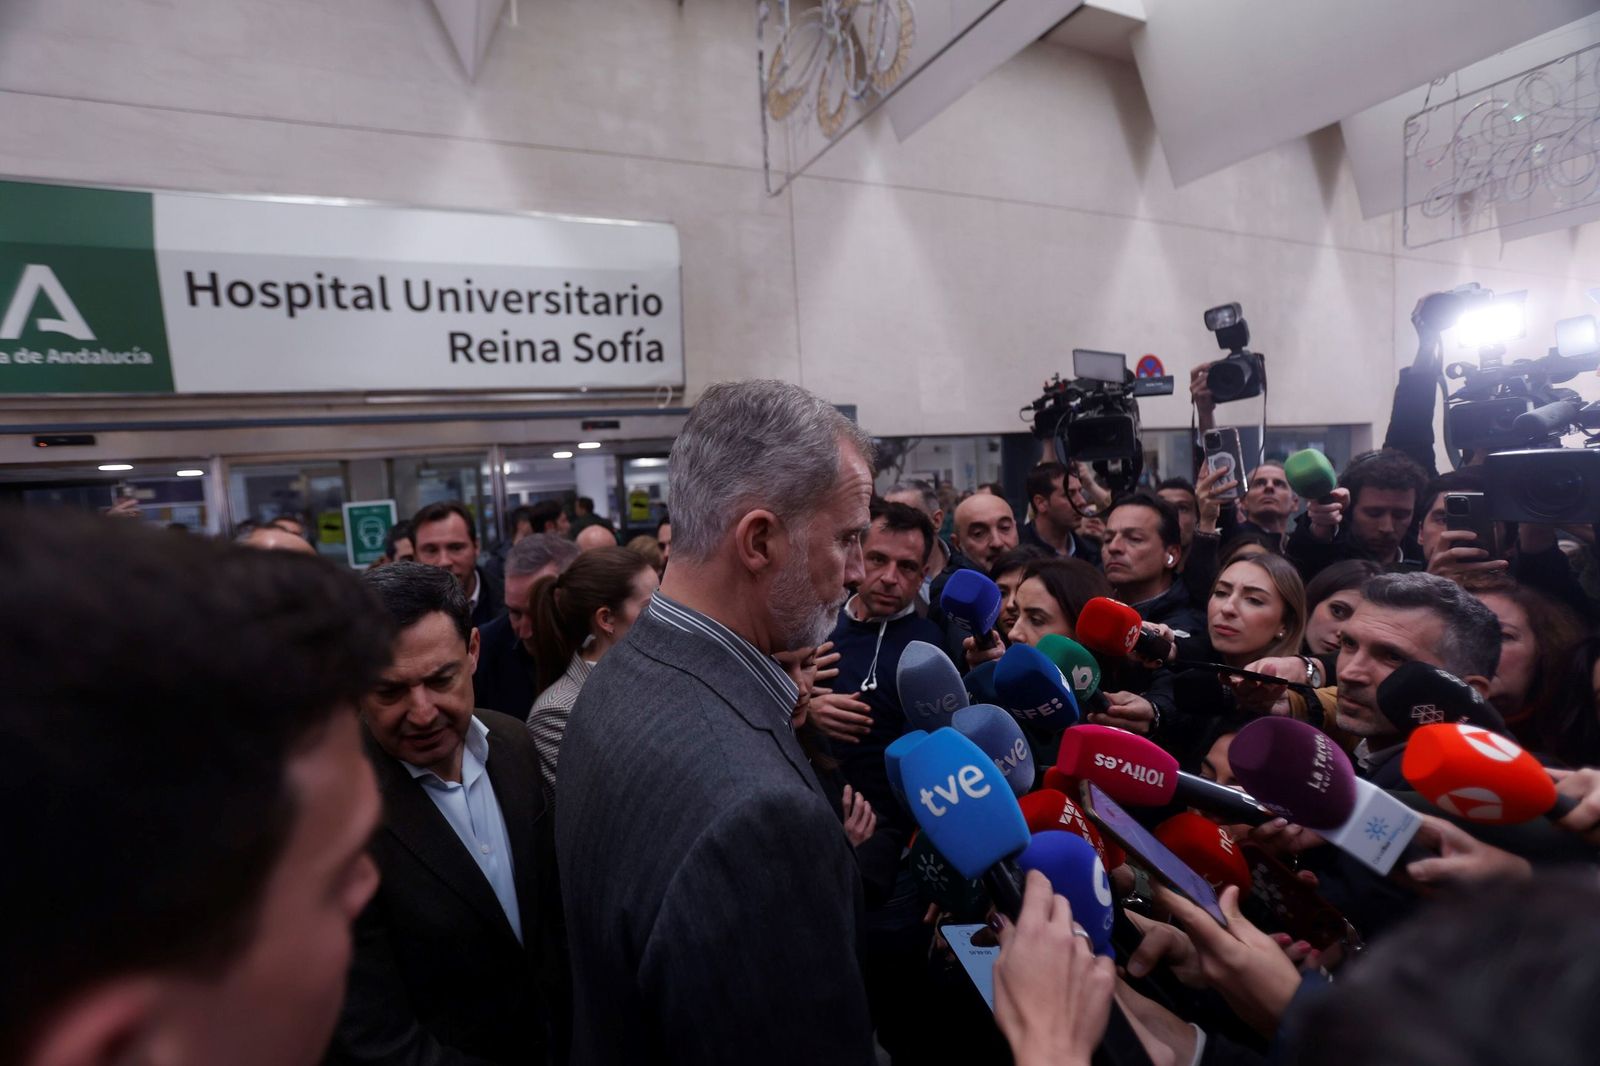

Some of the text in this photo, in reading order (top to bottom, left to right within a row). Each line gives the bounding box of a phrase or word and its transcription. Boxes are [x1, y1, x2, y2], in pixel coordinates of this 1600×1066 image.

[185, 271, 664, 318] Hospital Universitario
[13, 347, 43, 364] de
[46, 346, 153, 364] Andalucía
[448, 328, 665, 364] Reina Sofía
[915, 693, 960, 717] tve
[994, 738, 1028, 776] tve
[1306, 734, 1327, 789] La Tarde
[919, 765, 992, 817] tve
